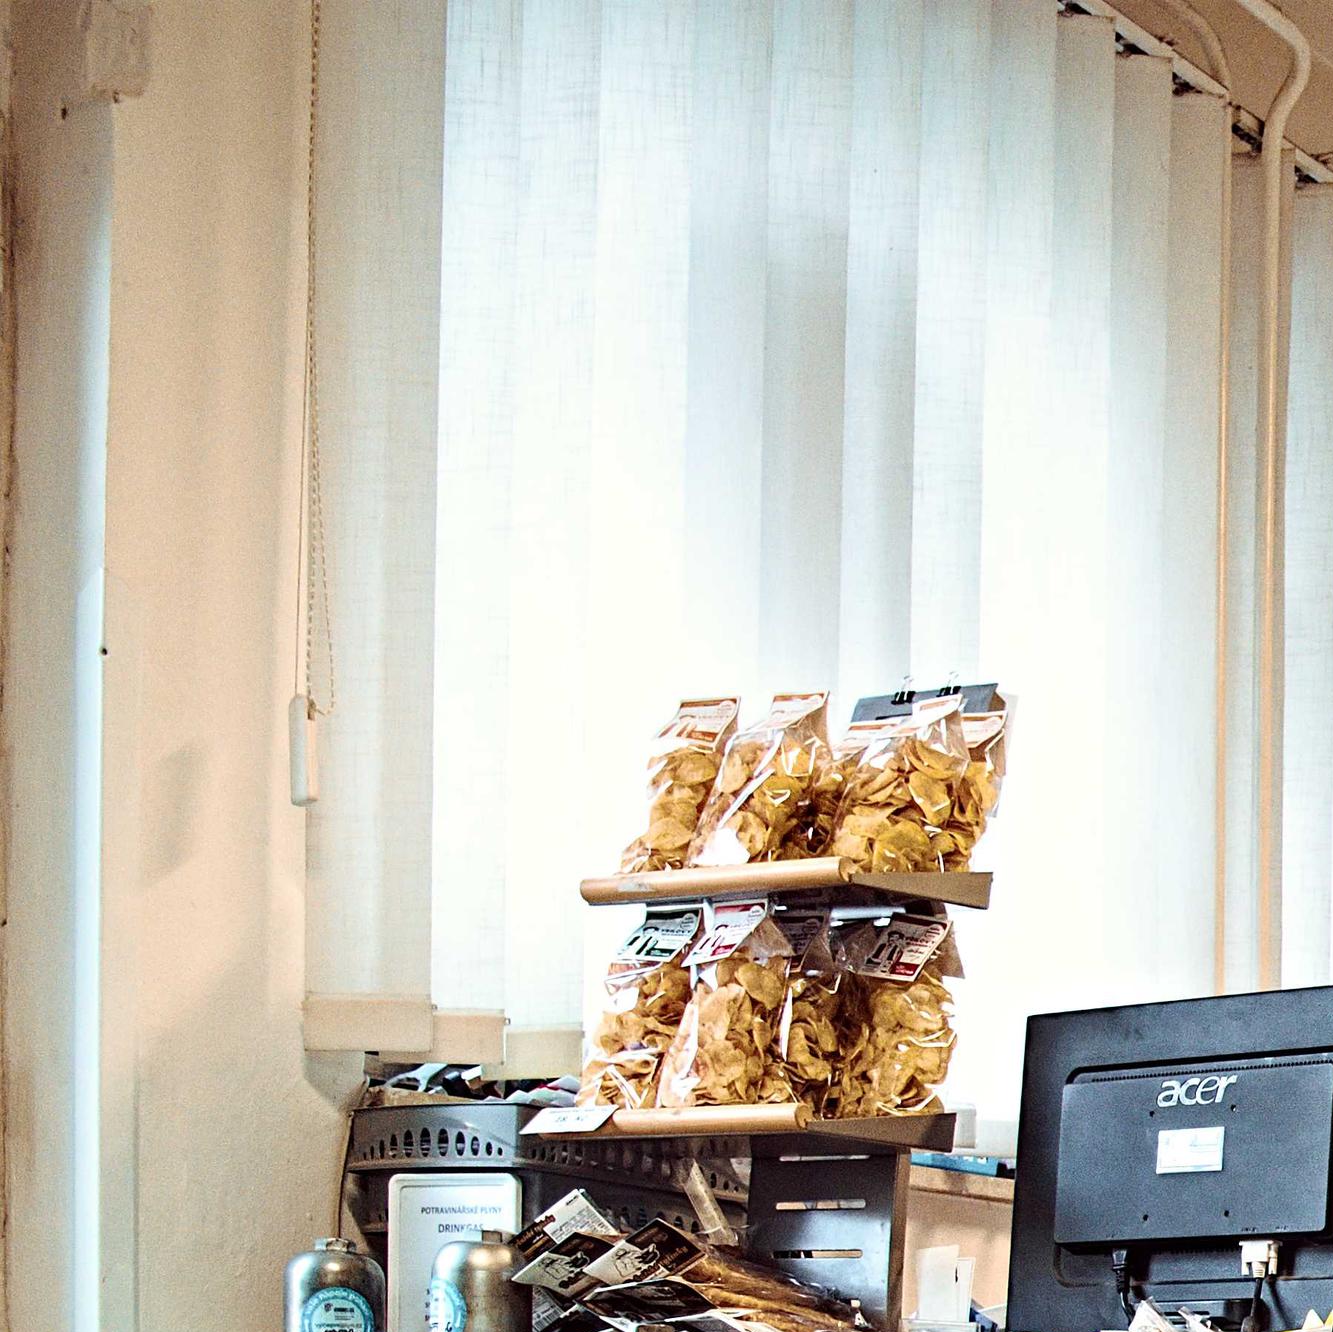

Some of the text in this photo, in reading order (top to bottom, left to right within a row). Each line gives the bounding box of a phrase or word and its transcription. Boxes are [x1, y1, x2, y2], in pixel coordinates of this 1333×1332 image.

[1156, 1073, 1238, 1108] acer
[420, 1205, 503, 1216] POTRAVINÁŘSKÉ PLYNY
[437, 1222, 485, 1234] DRINKGAS
